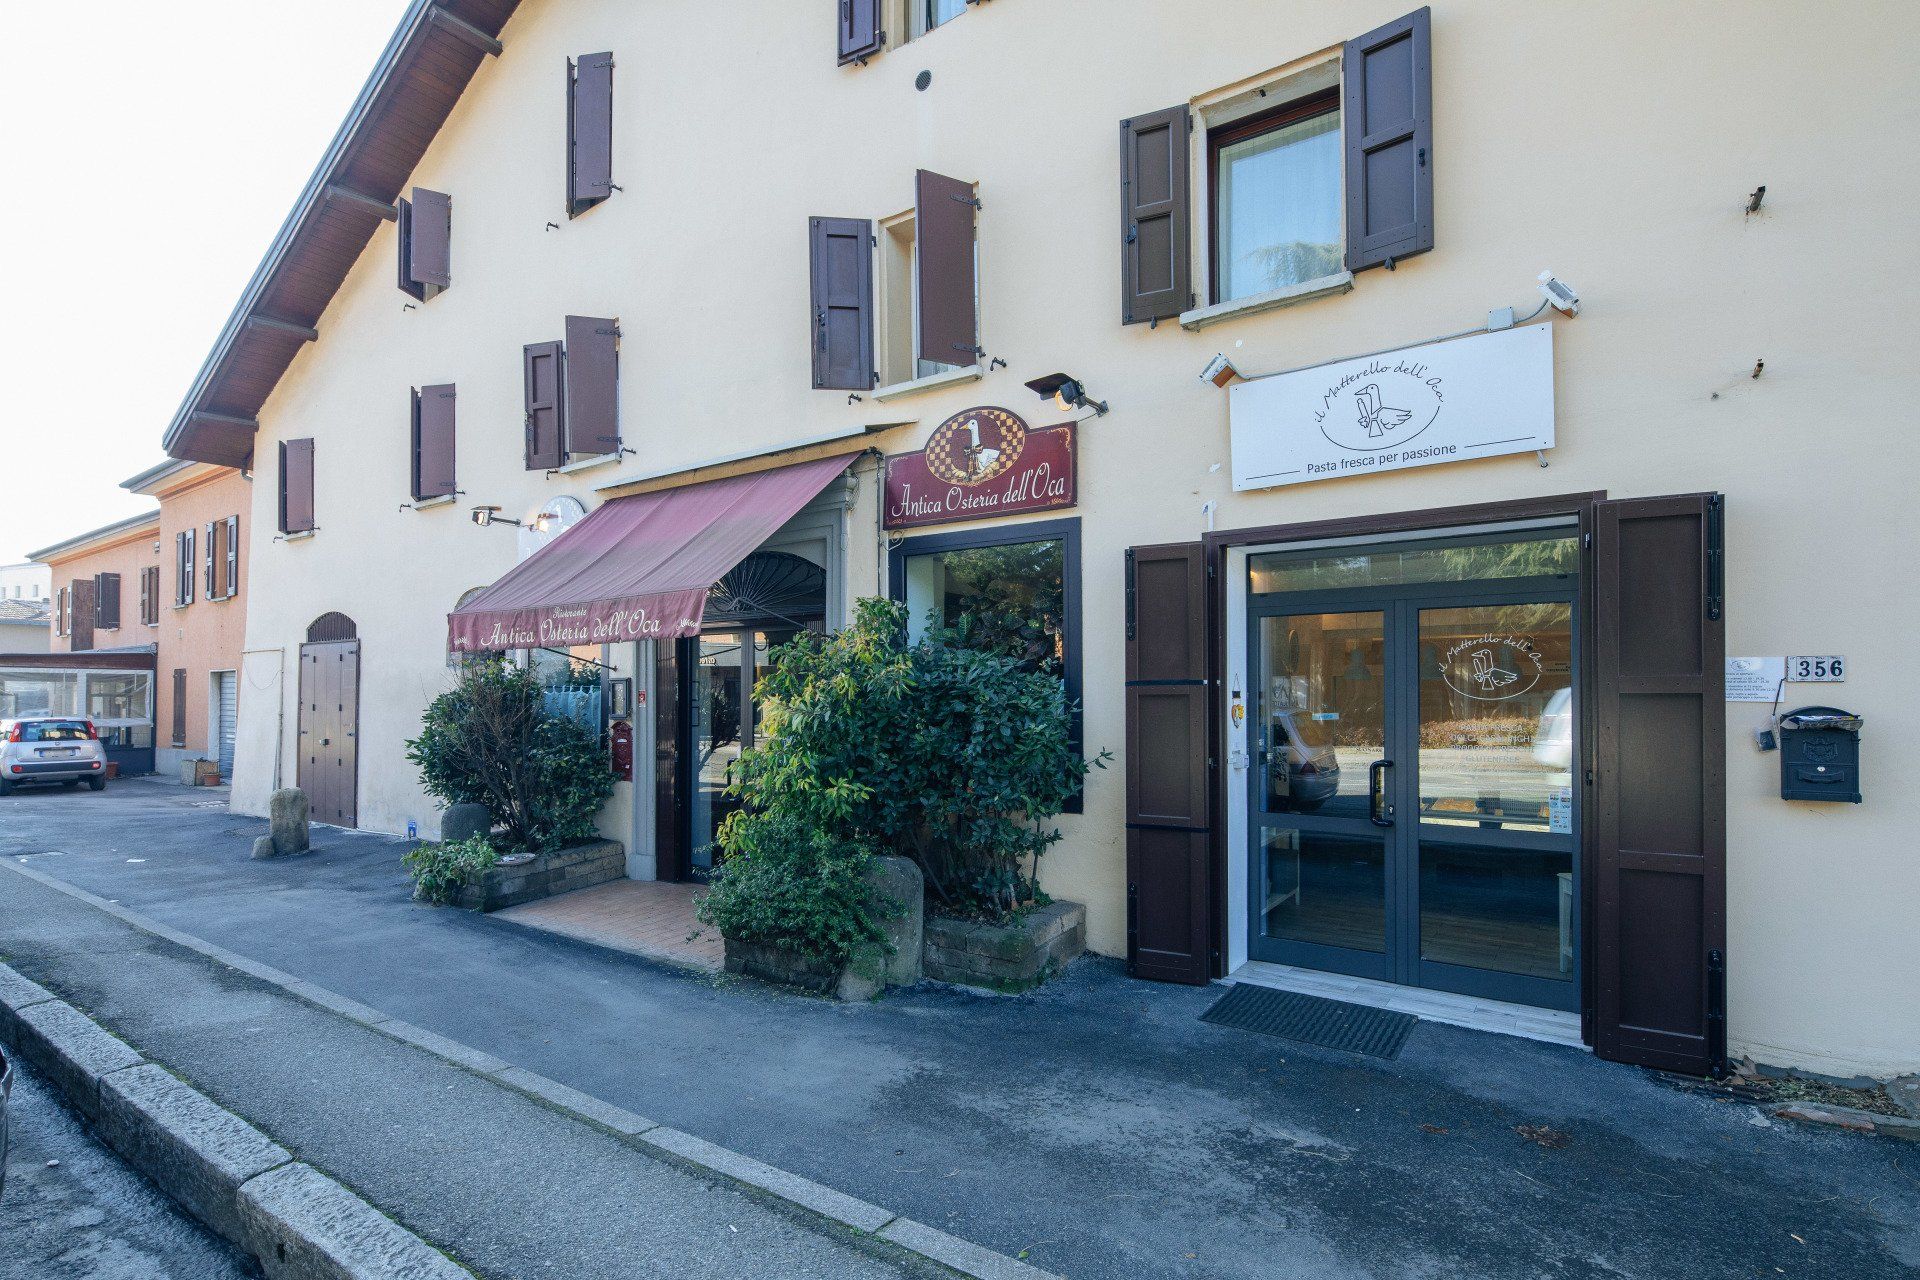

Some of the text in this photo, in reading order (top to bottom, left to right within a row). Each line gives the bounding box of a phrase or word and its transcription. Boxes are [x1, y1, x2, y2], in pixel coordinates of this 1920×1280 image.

[1314, 406, 1327, 424] il
[1323, 361, 1391, 409] Matterello
[1425, 376, 1445, 403] Oca
[1306, 443, 1458, 475] Pasta fresca per passione
[891, 462, 1065, 517] Antica Osteria dell'Oca
[480, 622, 535, 646] Antica
[540, 617, 588, 642] Osteria
[593, 608, 662, 639] dell'Oca
[1438, 662, 1448, 673] il
[1446, 633, 1501, 664] Matterello
[1528, 652, 1543, 673] Oca
[1797, 660, 1843, 678] 356
